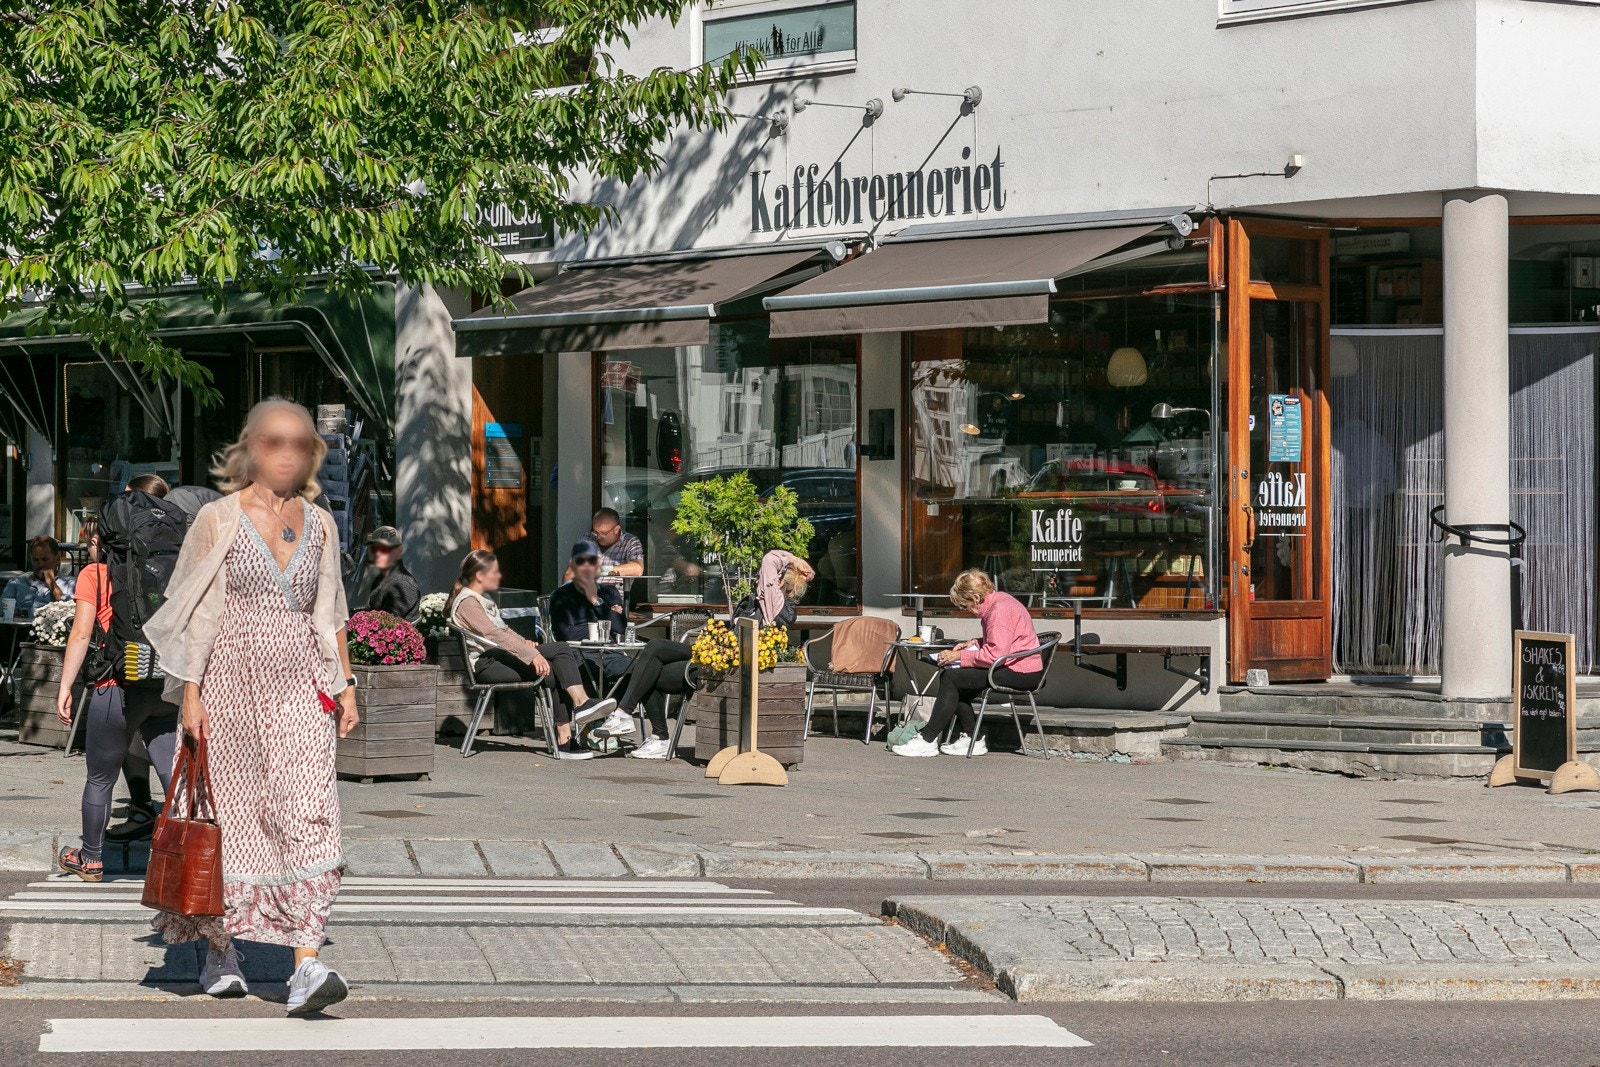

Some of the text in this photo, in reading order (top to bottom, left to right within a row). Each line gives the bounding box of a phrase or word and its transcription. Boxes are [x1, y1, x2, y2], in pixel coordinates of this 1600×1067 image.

[735, 30, 824, 57] Klinikk for Alle
[750, 145, 1007, 233] Kaffebrenneriet
[1030, 508, 1083, 543] Kaffe
[1030, 544, 1083, 562] brenneriet
[1522, 646, 1563, 666] SHAKES
[1535, 665, 1545, 683] &
[1523, 684, 1558, 702] ISKREM
